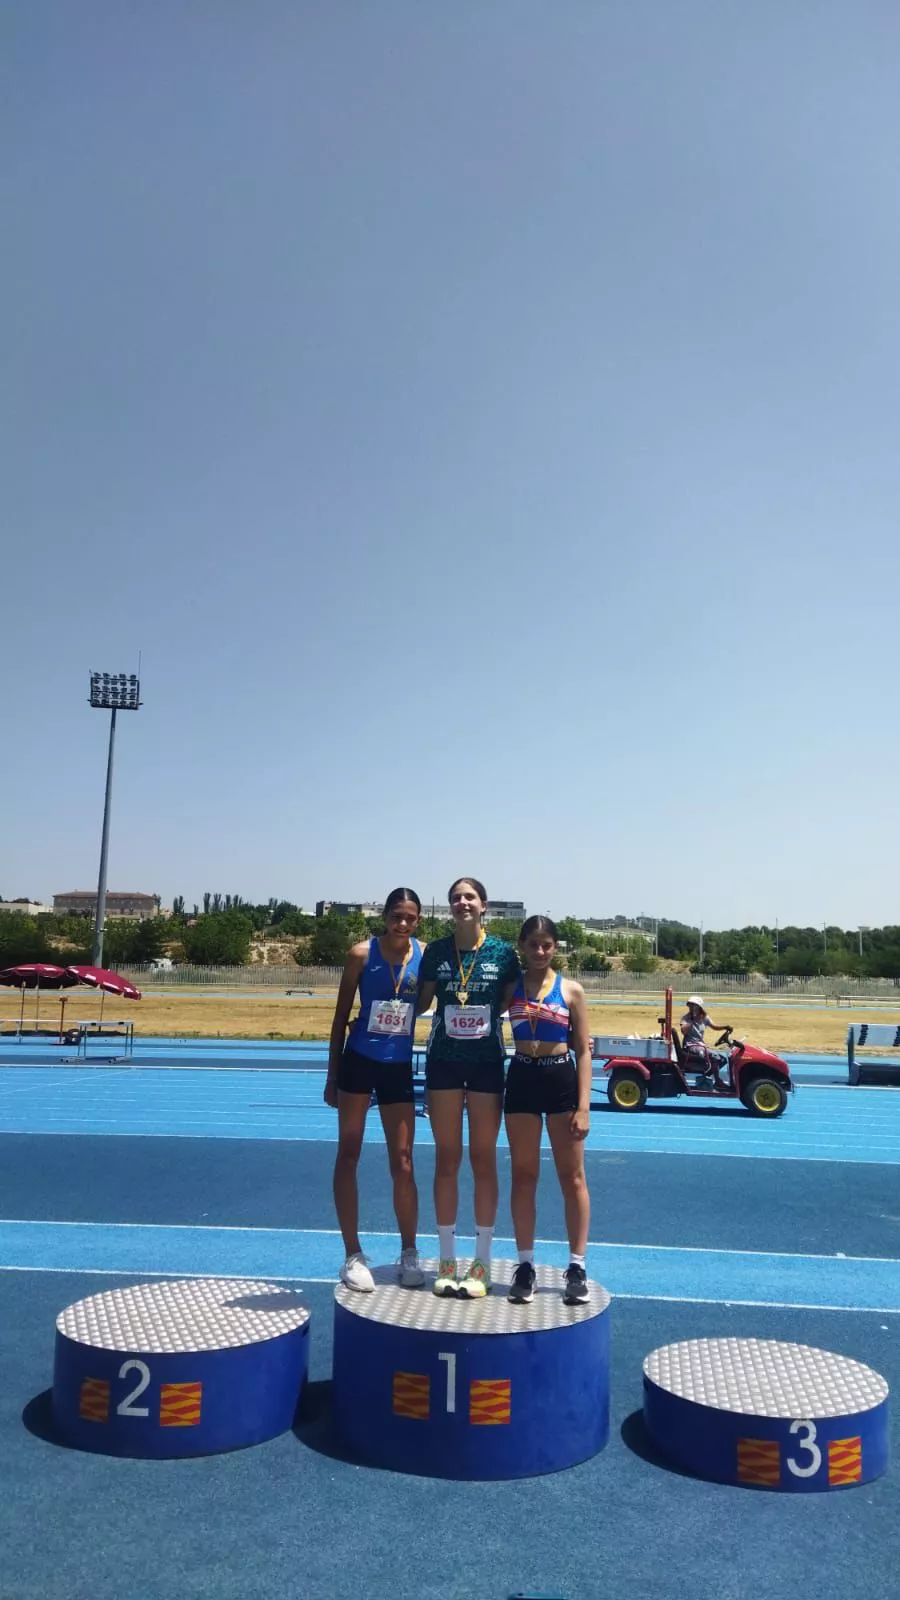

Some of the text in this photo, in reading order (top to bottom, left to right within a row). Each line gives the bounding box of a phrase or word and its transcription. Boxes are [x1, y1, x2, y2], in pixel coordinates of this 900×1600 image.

[376, 1012, 407, 1026] 1631
[450, 1016, 485, 1028] 1624
[537, 1055, 566, 1067] NIKE
[116, 1359, 151, 1417] 2
[438, 1352, 457, 1413] 1
[786, 1419, 822, 1478] 3
